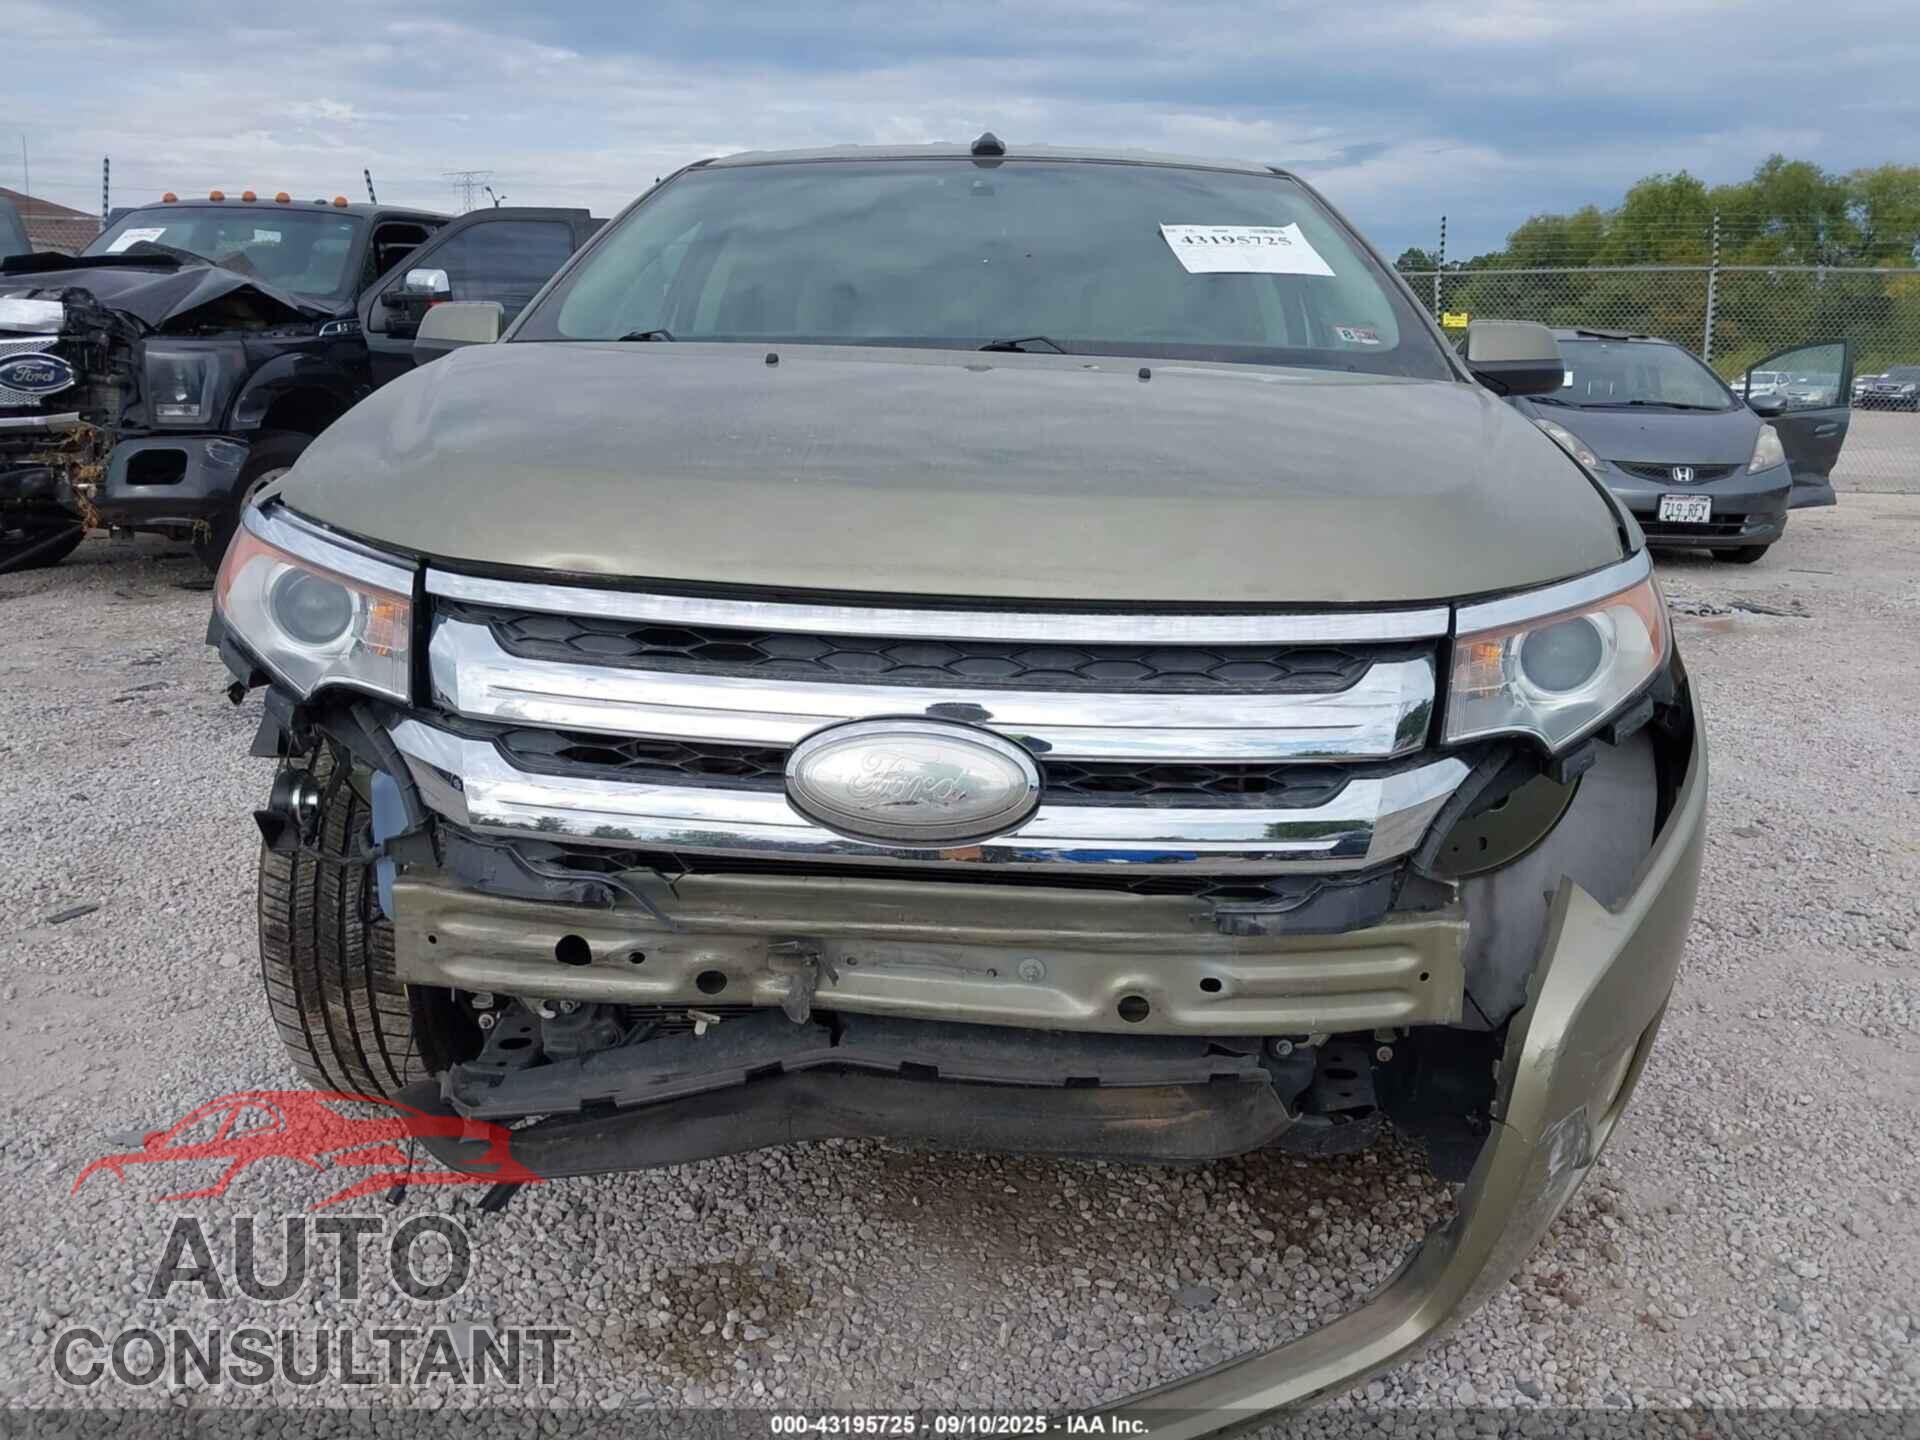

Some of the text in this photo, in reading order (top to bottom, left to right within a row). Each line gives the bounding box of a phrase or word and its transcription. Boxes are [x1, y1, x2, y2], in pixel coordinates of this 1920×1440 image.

[1180, 235, 1293, 245] 43195725
[13, 365, 55, 382] Ford
[849, 753, 967, 801] Ford
